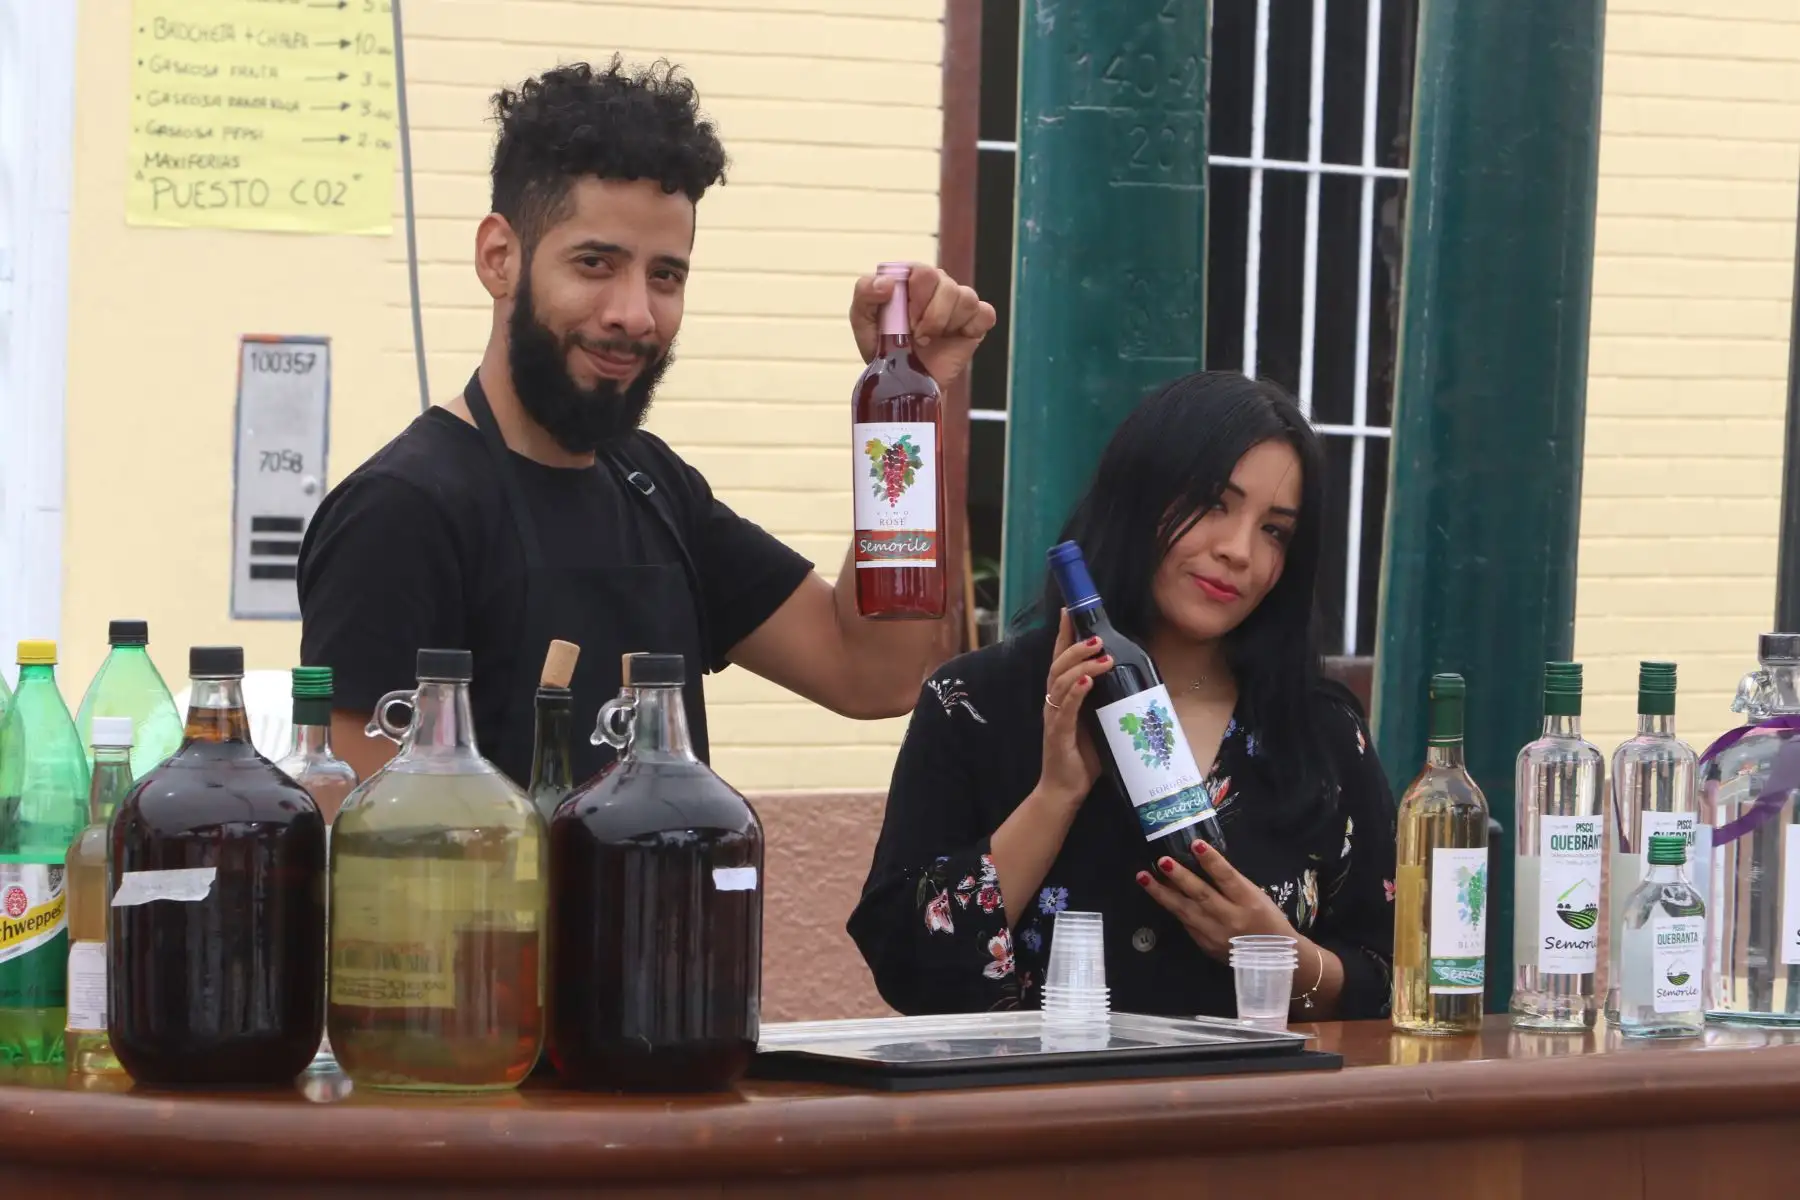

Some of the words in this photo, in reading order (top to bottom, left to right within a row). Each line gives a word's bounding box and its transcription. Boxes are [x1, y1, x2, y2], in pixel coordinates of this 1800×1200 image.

[143, 151, 241, 170] MAXIFERIAS
[250, 351, 317, 375] 100357
[258, 450, 304, 474] 7058
[859, 537, 930, 554] Semorile
[1575, 822, 1594, 833] PISCO
[1657, 932, 1699, 946] QUEBRANTA
